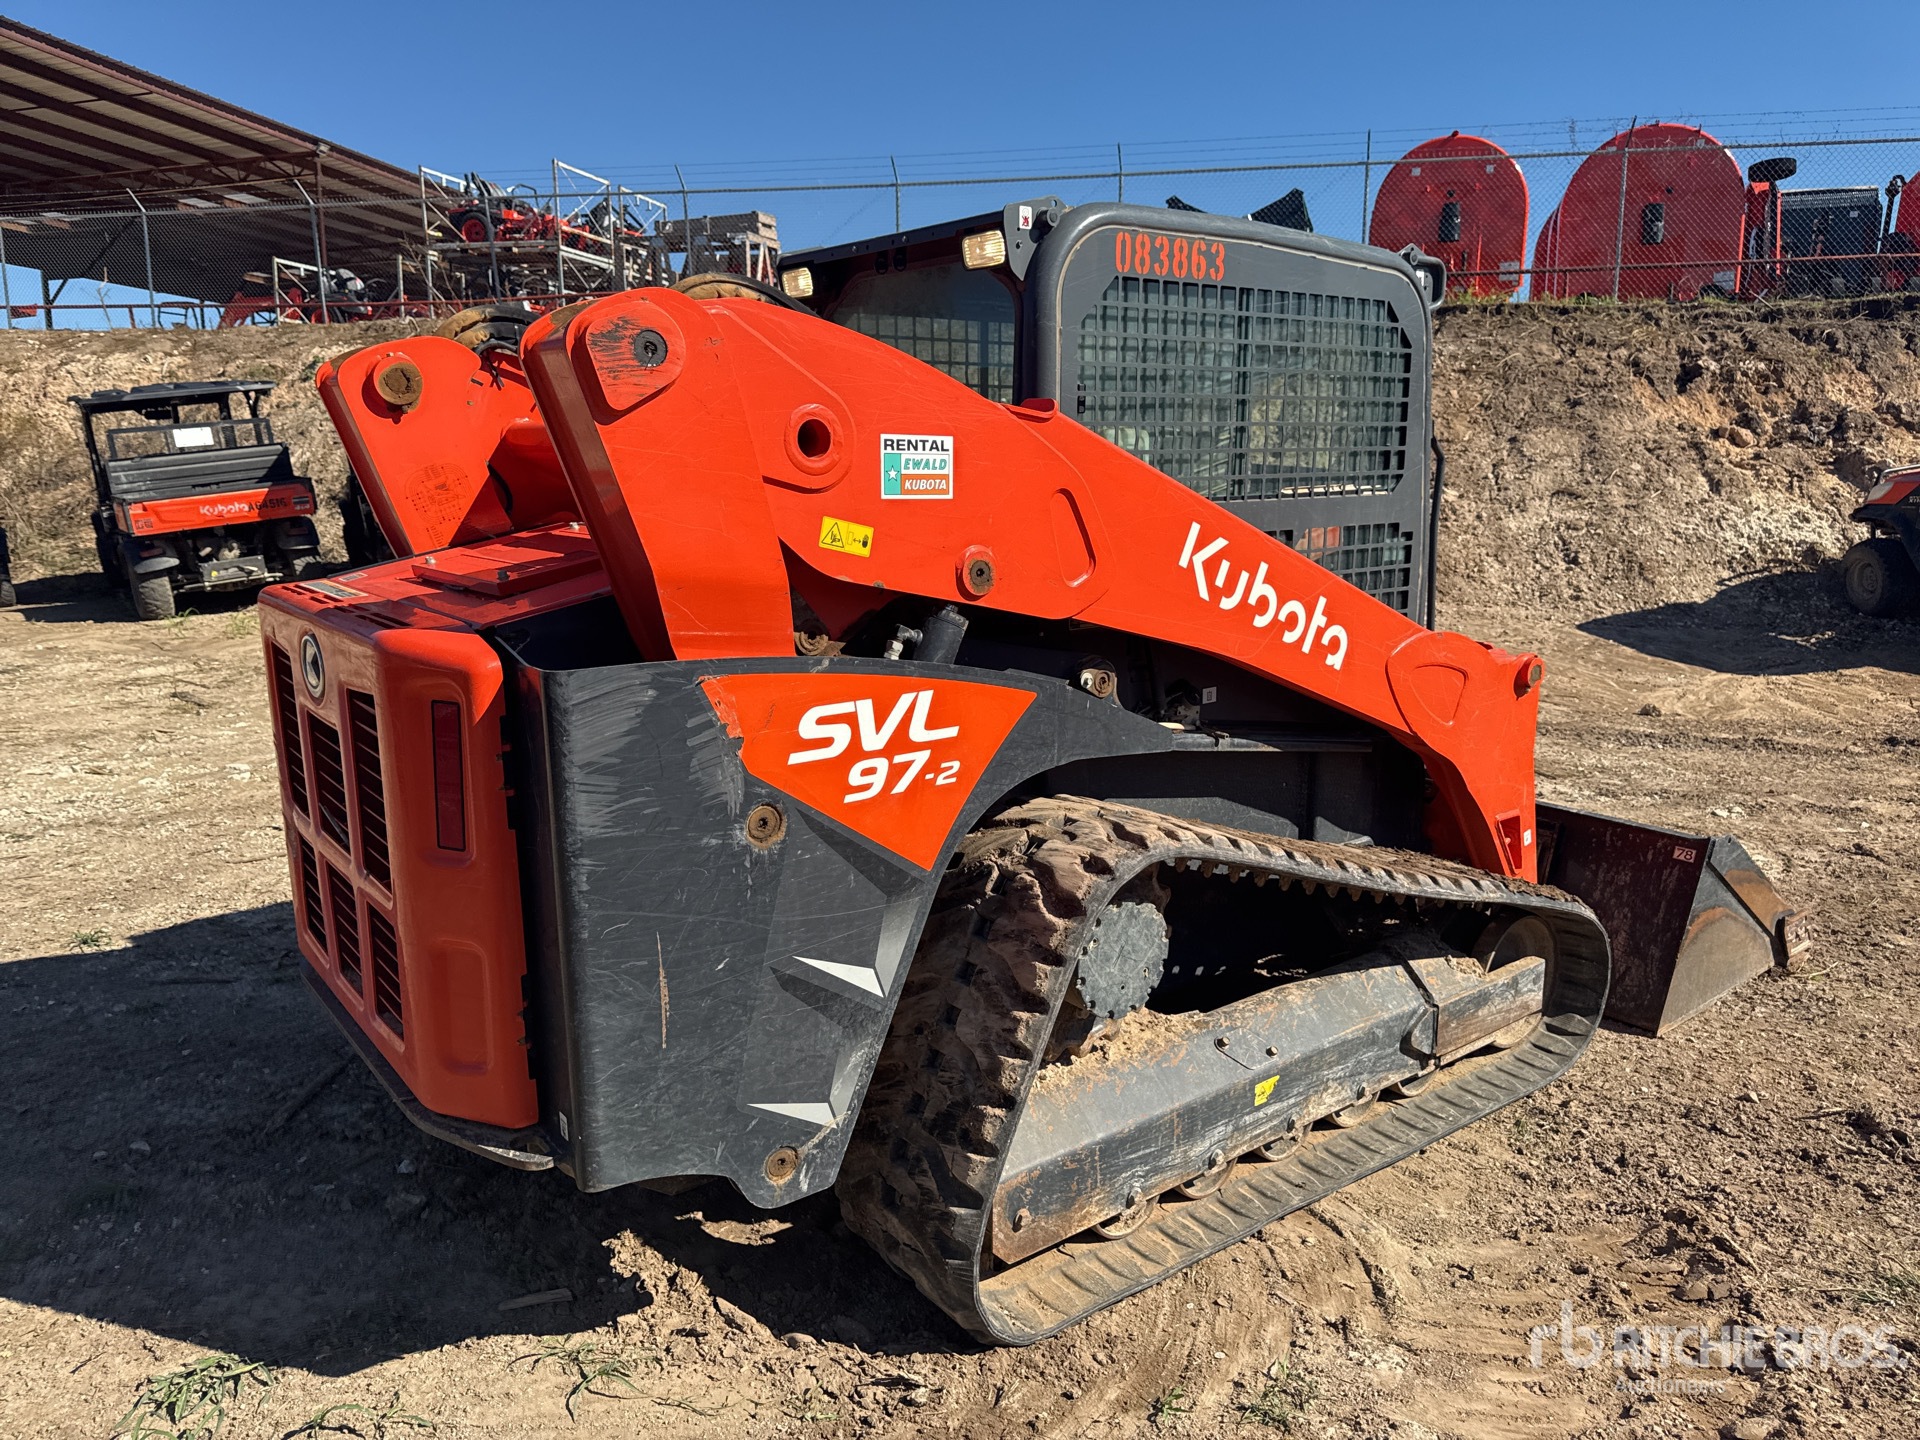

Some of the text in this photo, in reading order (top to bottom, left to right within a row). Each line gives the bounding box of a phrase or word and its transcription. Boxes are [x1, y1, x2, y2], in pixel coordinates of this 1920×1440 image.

[1115, 231, 1226, 281] 083863
[883, 438, 950, 452] RENTAL
[903, 458, 948, 471] EWALD
[904, 478, 947, 490] KUBOTA
[199, 501, 249, 516] Kubota
[1178, 520, 1348, 671] Kubota
[787, 689, 960, 766] SVL
[843, 749, 961, 804] 97-2
[1676, 847, 1695, 861] 78
